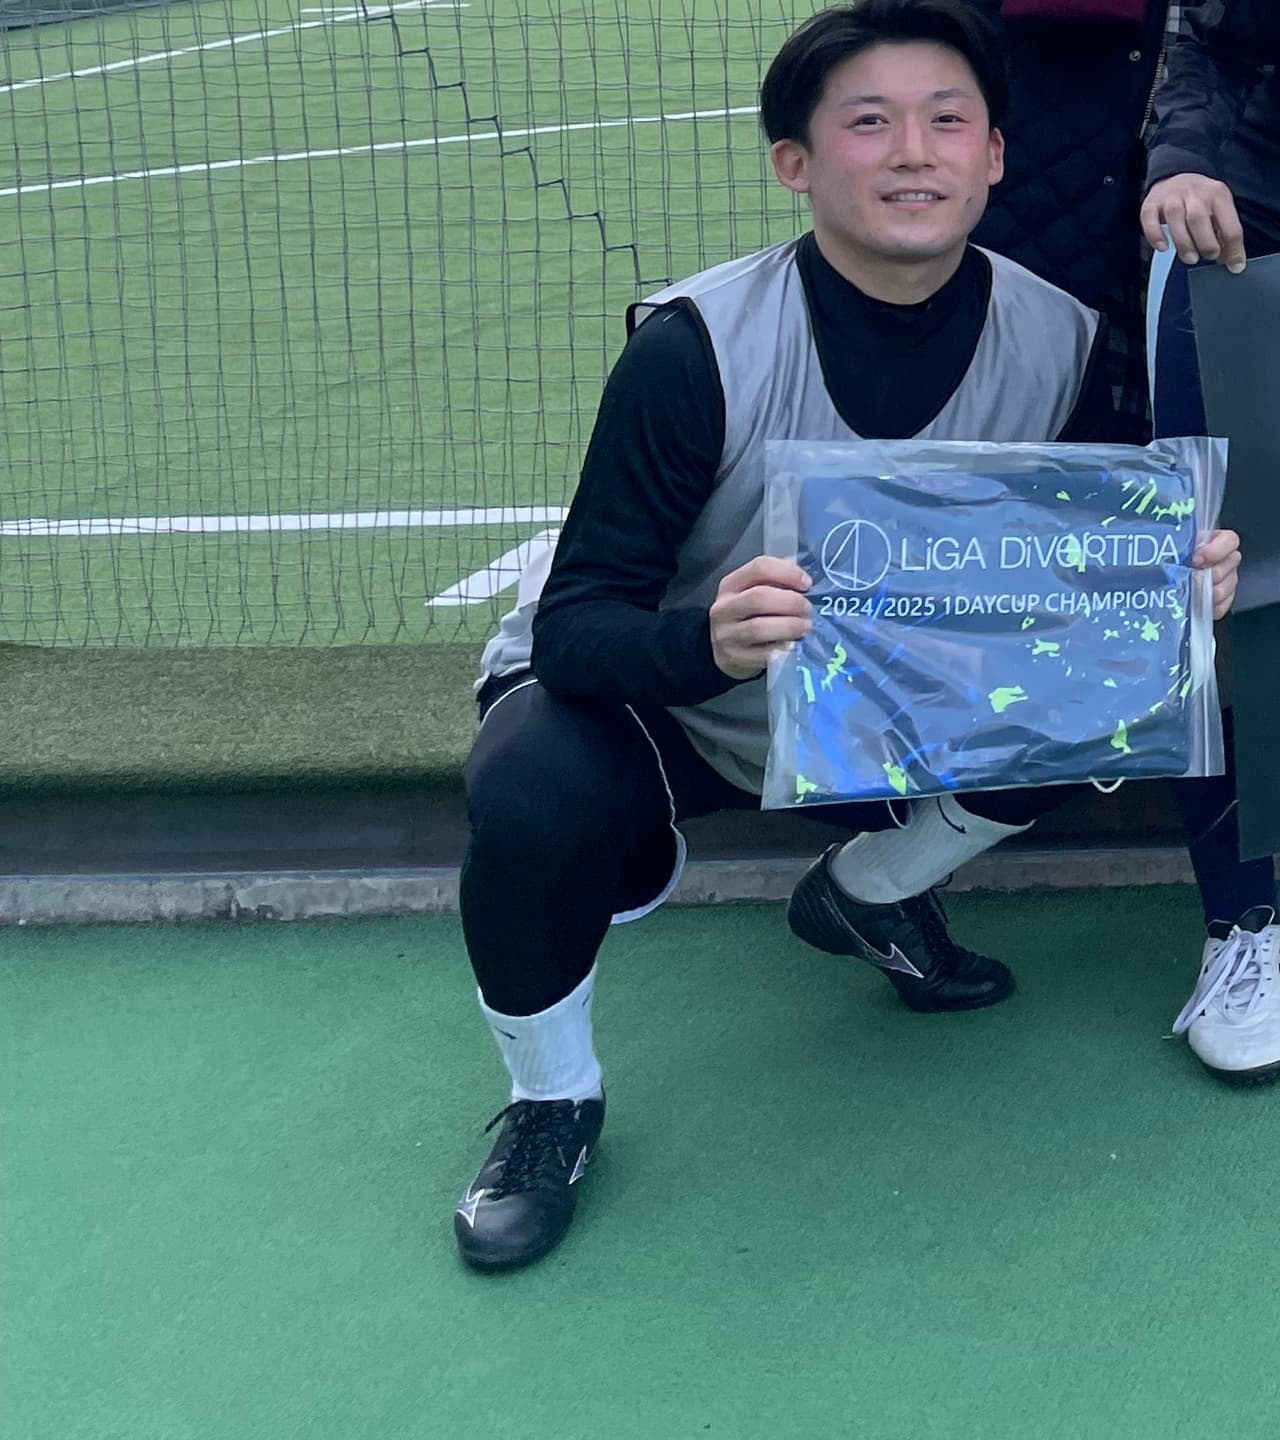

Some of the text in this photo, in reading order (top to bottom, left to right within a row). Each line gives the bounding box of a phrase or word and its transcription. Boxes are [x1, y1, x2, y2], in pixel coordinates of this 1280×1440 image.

[820, 589, 1178, 620] 2024/2025 1DAYCUP CHAMPIONS
